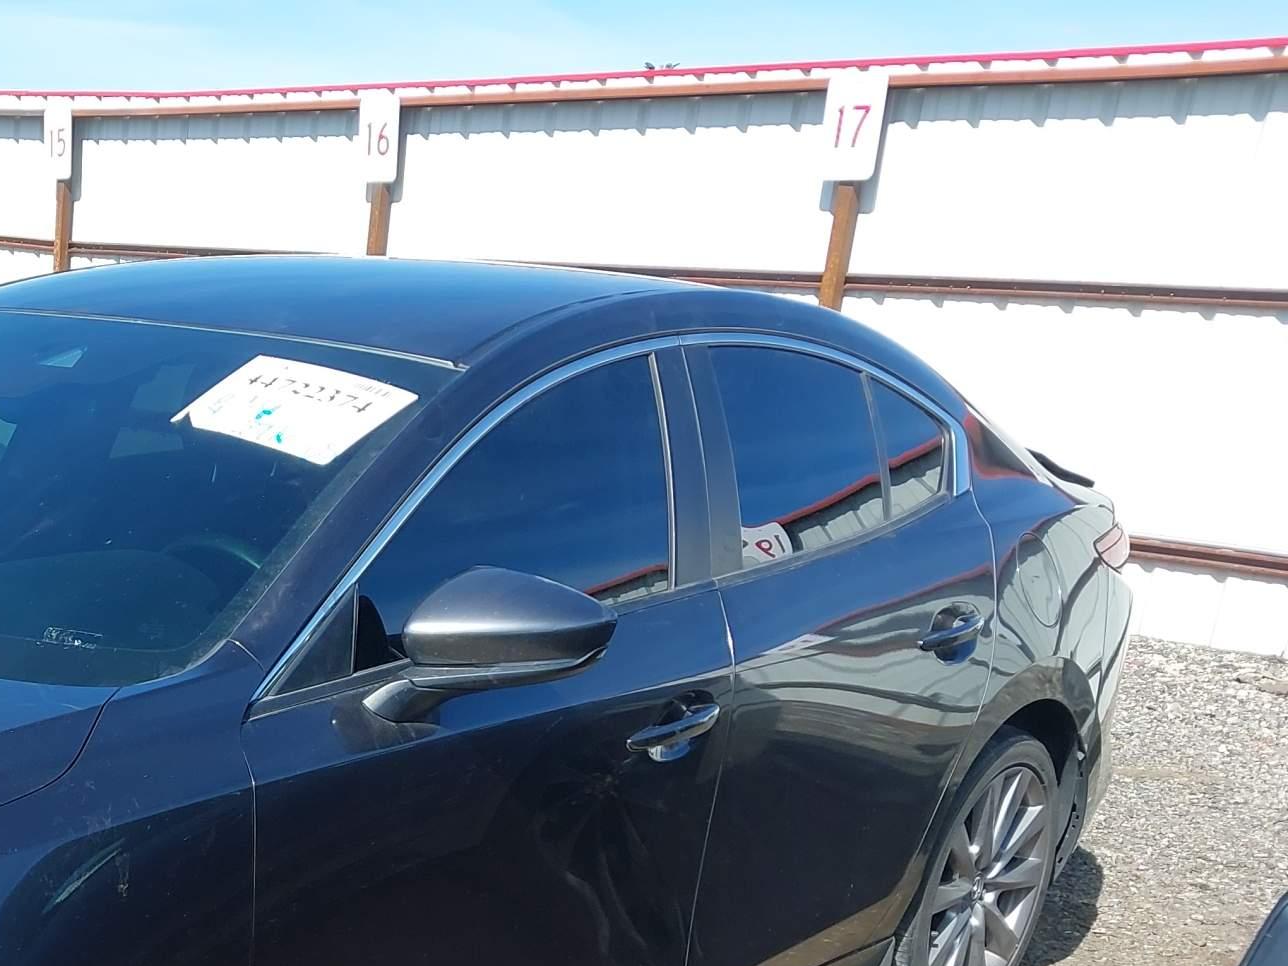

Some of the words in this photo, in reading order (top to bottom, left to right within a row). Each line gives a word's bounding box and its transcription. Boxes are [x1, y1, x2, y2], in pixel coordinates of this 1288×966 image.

[49, 127, 66, 158] 15
[367, 121, 390, 156] 16
[834, 104, 871, 148] 17
